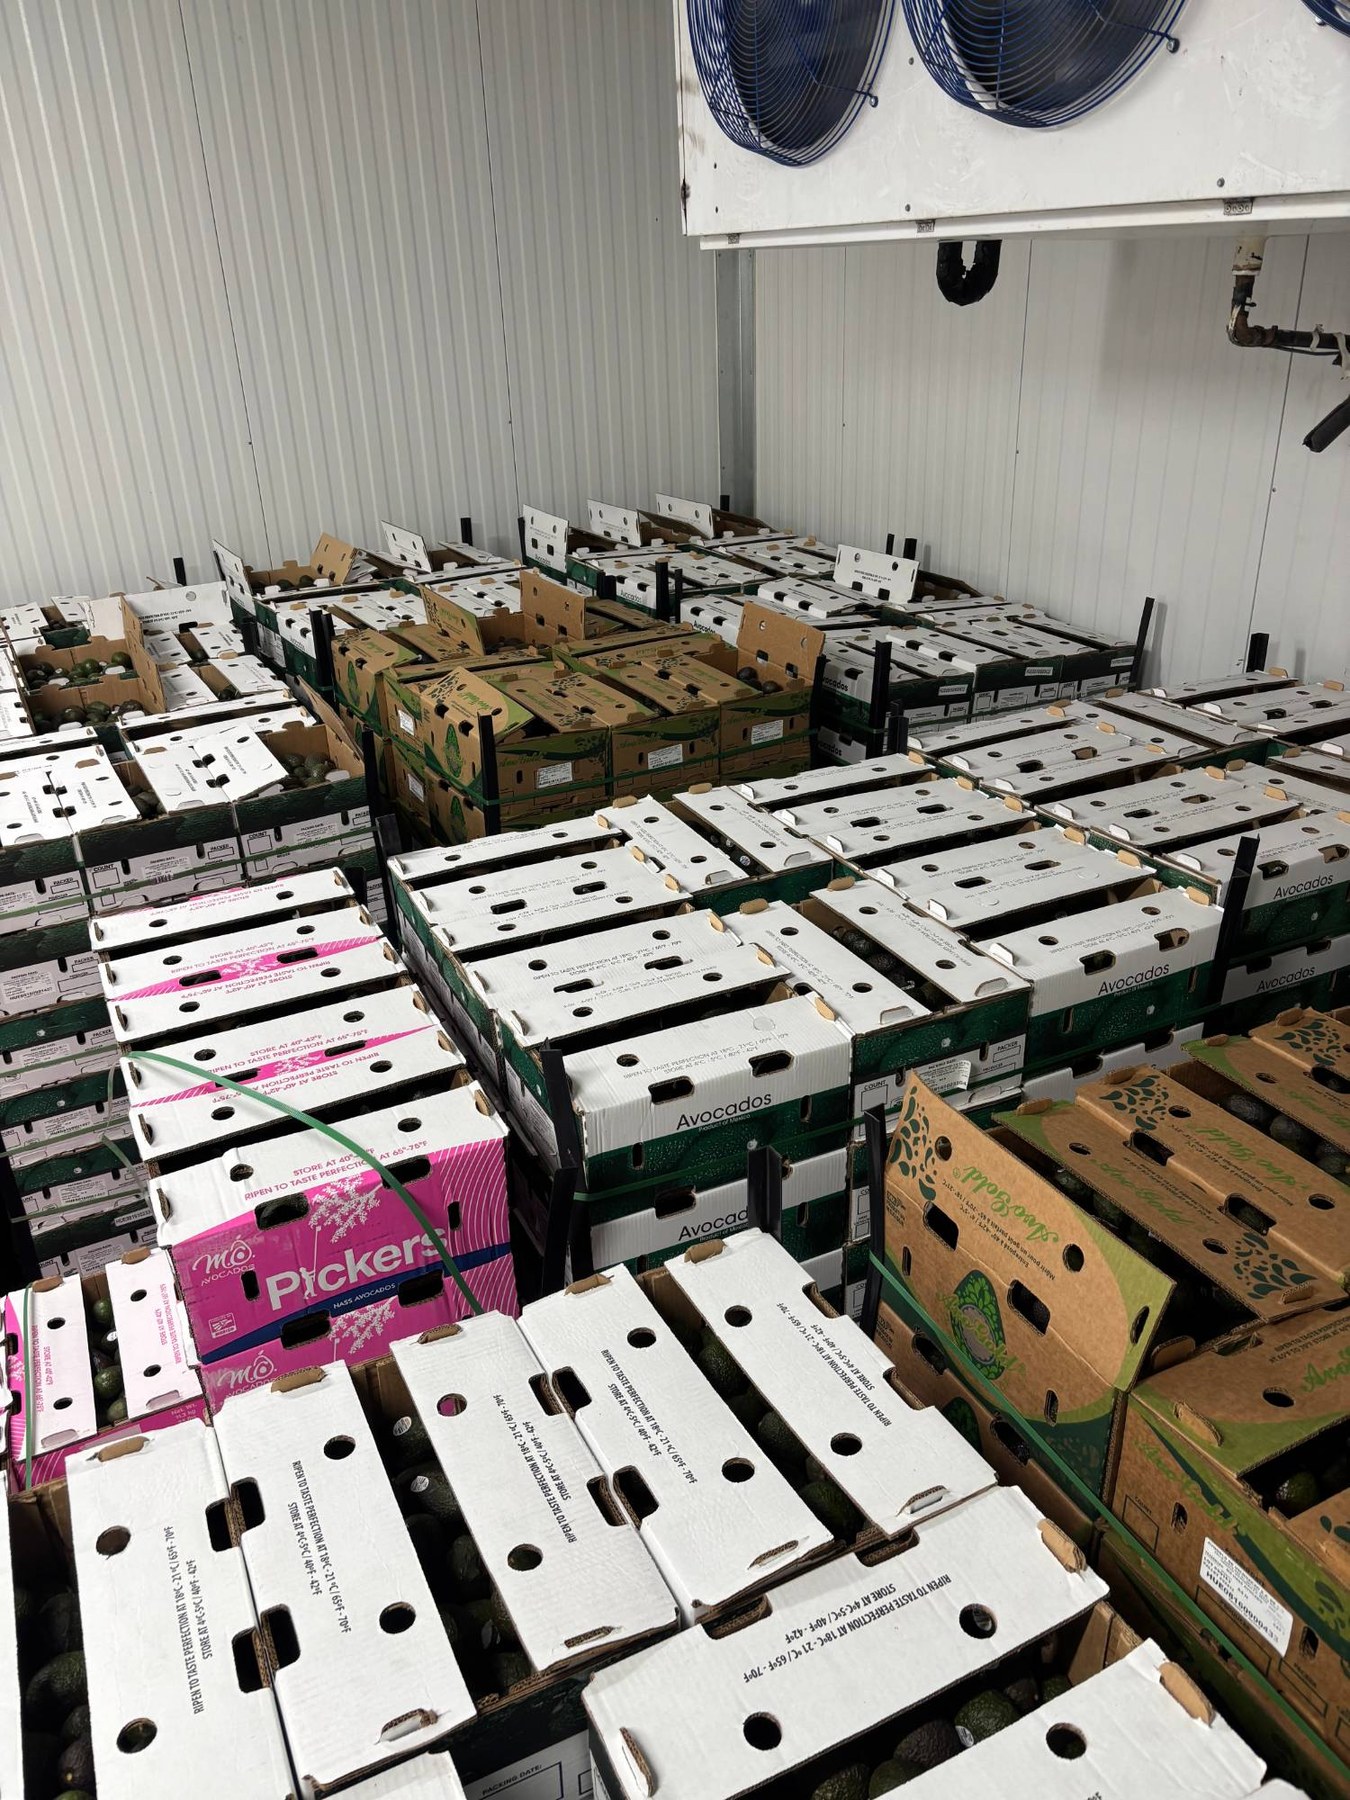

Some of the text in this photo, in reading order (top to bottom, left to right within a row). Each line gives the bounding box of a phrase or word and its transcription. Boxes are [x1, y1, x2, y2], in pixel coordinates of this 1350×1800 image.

[248, 831, 268, 839] COUNT
[93, 863, 115, 872] COUNT
[1273, 874, 1334, 900] Avocados
[1098, 964, 1170, 996] Avocados
[1256, 966, 1316, 993] Avocados
[248, 1054, 271, 1064] TASTE
[273, 1041, 323, 1057] PERFECTION
[250, 1046, 275, 1056] STORE
[997, 1040, 1019, 1052] PACKER
[355, 1052, 379, 1062] RIPEN
[311, 1071, 338, 1082] STORE
[316, 1063, 340, 1073] TASTE
[262, 1070, 314, 1088] PERFECTION
[863, 1079, 887, 1092] COUNT
[676, 1093, 772, 1131] Avocados
[293, 1148, 373, 1176] STORE AT 40°-°F
[245, 1186, 272, 1200] RIPEN
[274, 1182, 288, 1191] TO
[290, 1173, 317, 1186] TASTE
[319, 1156, 371, 1178] PERFECTIO
[380, 1152, 389, 1160] AT
[678, 1206, 749, 1241] Avocad
[333, 1283, 397, 1309] HASS AVOCADOS
[822, 1353, 832, 1361] AT
[827, 1359, 857, 1389] PERFECTION
[851, 1367, 861, 1375] AT
[600, 1349, 616, 1365] RIPEN
[610, 1363, 620, 1371] TO
[615, 1370, 630, 1386] TASTE
[624, 1384, 651, 1416] PERFECTION
[857, 1373, 875, 1390] STORE
[607, 1383, 624, 1400] STORE
[618, 1398, 628, 1407] AT
[853, 1387, 870, 1404] TASTE
[866, 1402, 877, 1411] TO
[873, 1409, 891, 1426] RIPEN
[524, 1454, 535, 1463] AT
[292, 1461, 305, 1479] RIPEN
[528, 1461, 553, 1497] PERFECTION
[551, 1473, 561, 1481] AT
[297, 1478, 307, 1487] TO
[555, 1480, 571, 1500] STORE
[299, 1487, 313, 1506] TASTE
[287, 1501, 301, 1524] STORE
[546, 1496, 562, 1516] TASTE
[293, 1521, 303, 1531] AT
[305, 1505, 324, 1544] PERFECTION
[556, 1514, 566, 1524] TO
[560, 1523, 577, 1543] RIPEN
[316, 1544, 327, 1552] AT
[870, 1583, 896, 1601] STORE
[916, 1585, 929, 1598] TO
[926, 1574, 951, 1592] RIPEN
[176, 1602, 186, 1612] AT
[860, 1594, 871, 1606] AT
[893, 1590, 918, 1609] TASTE
[847, 1601, 895, 1631] PERFECTION
[178, 1611, 193, 1656] PERFECTION
[198, 1625, 208, 1635] AT
[836, 1624, 847, 1637] AT
[200, 1635, 212, 1659] STORE
[185, 1654, 197, 1679] TASTE
[189, 1678, 199, 1690] TO
[190, 1689, 204, 1714] RIPEN
[482, 1764, 542, 1796] PACKING DATE:
